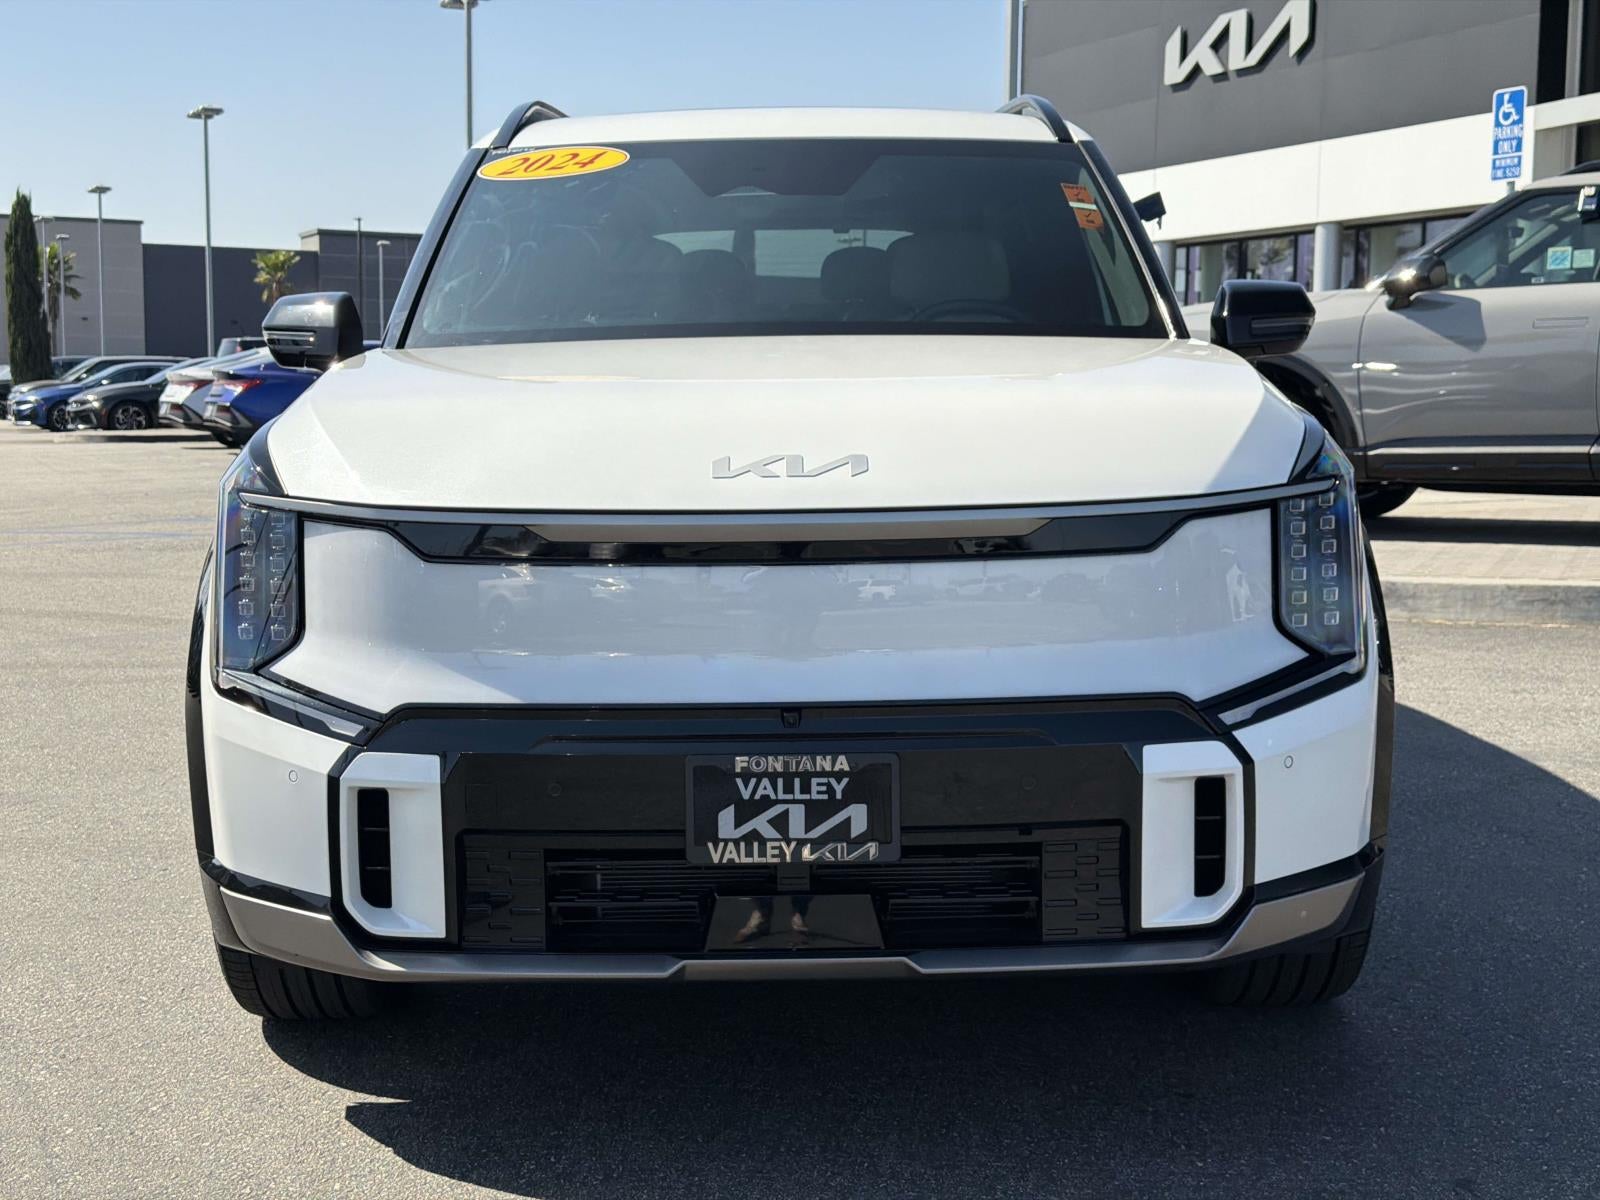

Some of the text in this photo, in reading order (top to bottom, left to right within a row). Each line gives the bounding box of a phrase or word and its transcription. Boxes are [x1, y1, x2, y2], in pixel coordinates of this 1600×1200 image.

[1163, 0, 1310, 86] KIA
[1493, 124, 1523, 139] PARKING
[1497, 139, 1518, 153] ONLY
[498, 151, 608, 176] 2024
[712, 454, 869, 479] KIA
[735, 755, 850, 773] FONTANA
[735, 777, 850, 800] VALLEY
[718, 803, 868, 839] KIA
[707, 841, 879, 864] VALLEY KIA
